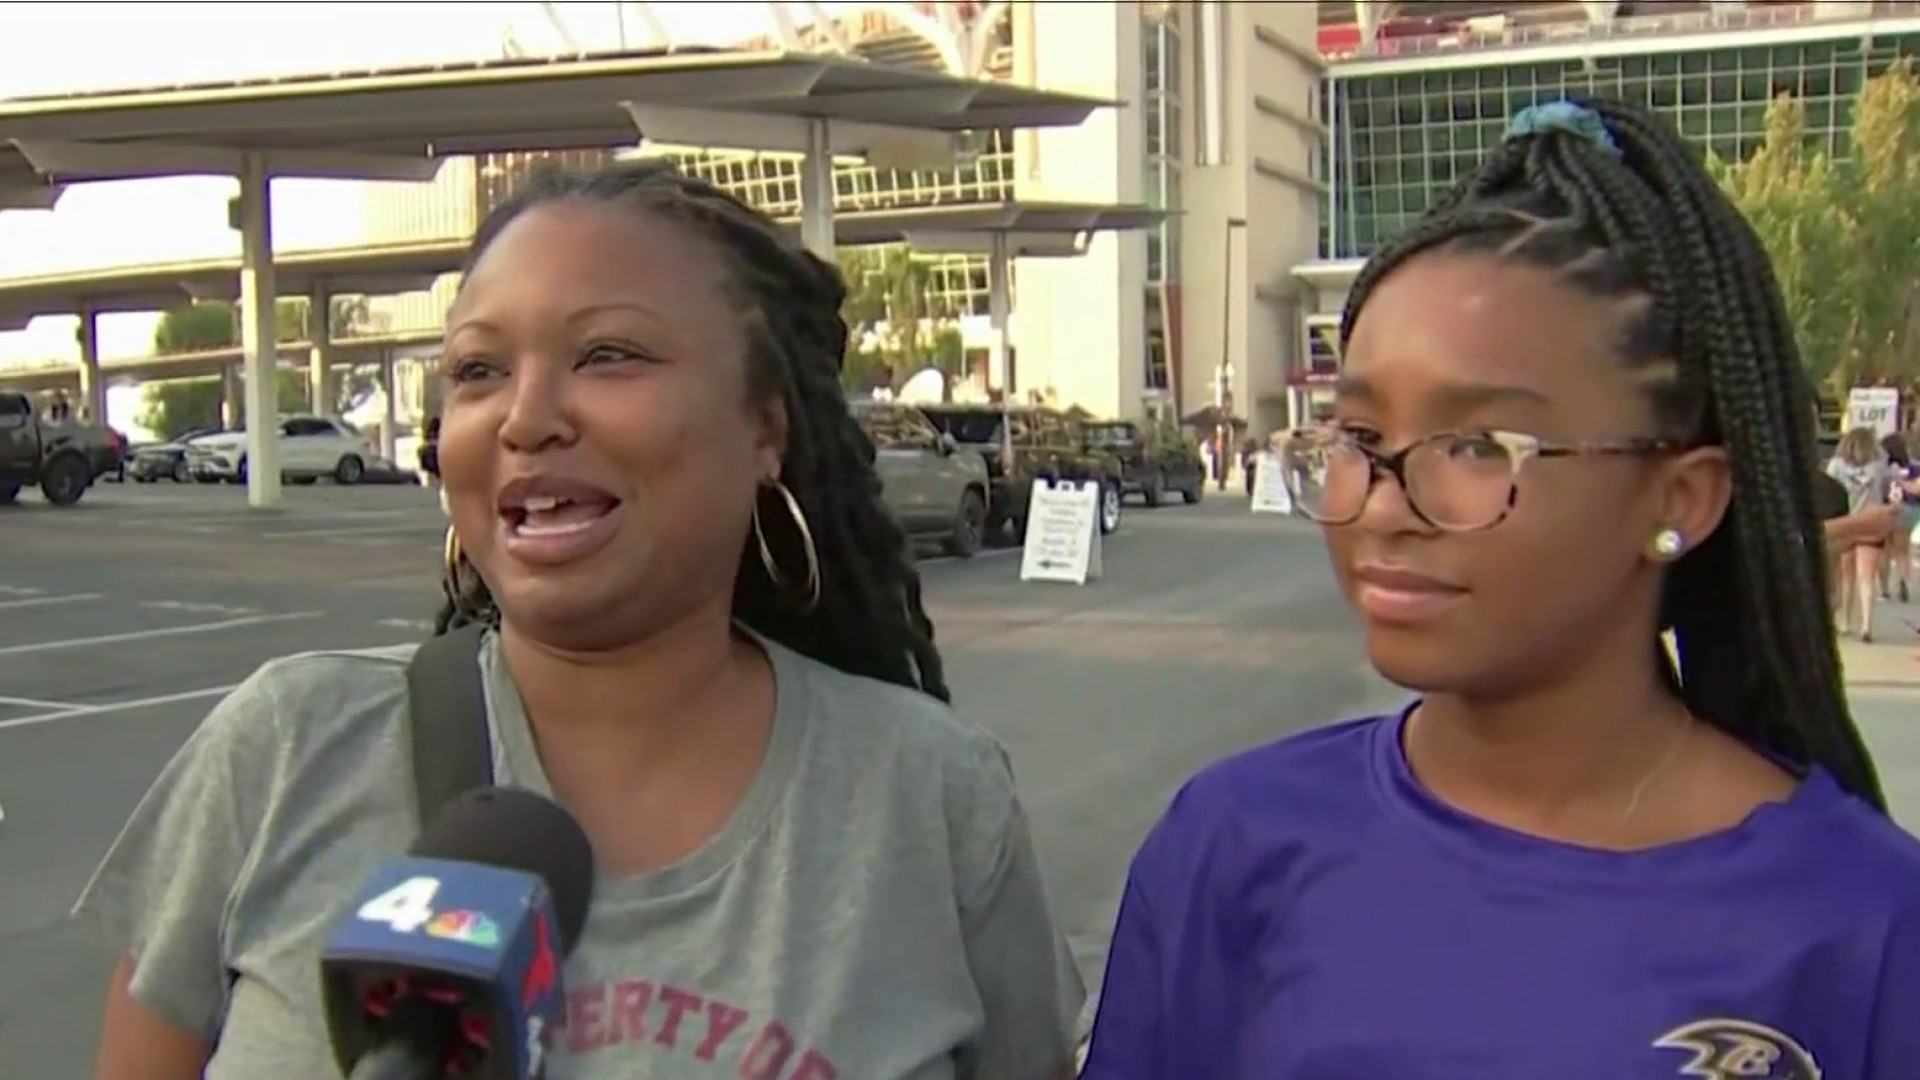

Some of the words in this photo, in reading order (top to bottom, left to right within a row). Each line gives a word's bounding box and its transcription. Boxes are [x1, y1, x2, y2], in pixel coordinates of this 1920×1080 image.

[1859, 408, 1886, 421] LOT
[357, 876, 441, 933] 4
[558, 981, 749, 1062] ERTY
